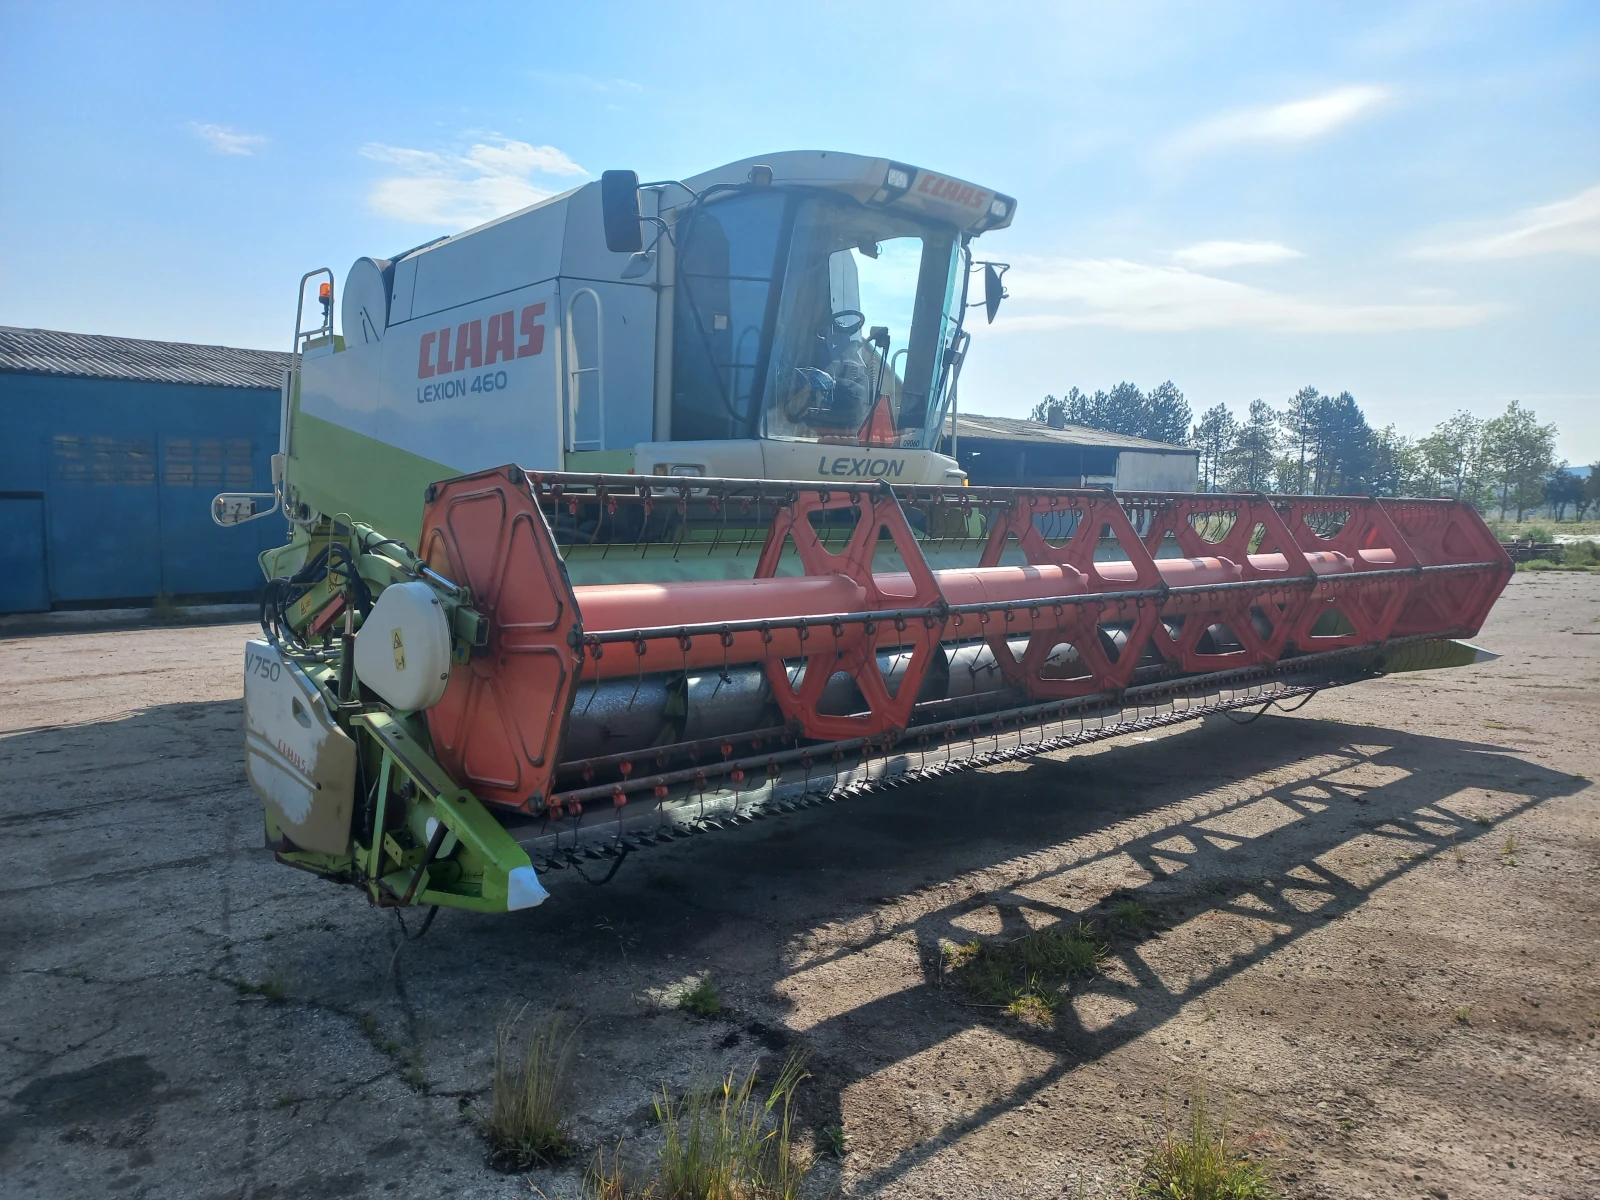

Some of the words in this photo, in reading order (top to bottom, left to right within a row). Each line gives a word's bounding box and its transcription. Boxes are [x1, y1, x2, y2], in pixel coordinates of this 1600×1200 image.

[918, 173, 989, 209] CLAAS
[417, 301, 546, 380] CLAAS
[417, 378, 466, 404] LEXION
[470, 370, 508, 394] 460
[818, 456, 905, 477] LEXION
